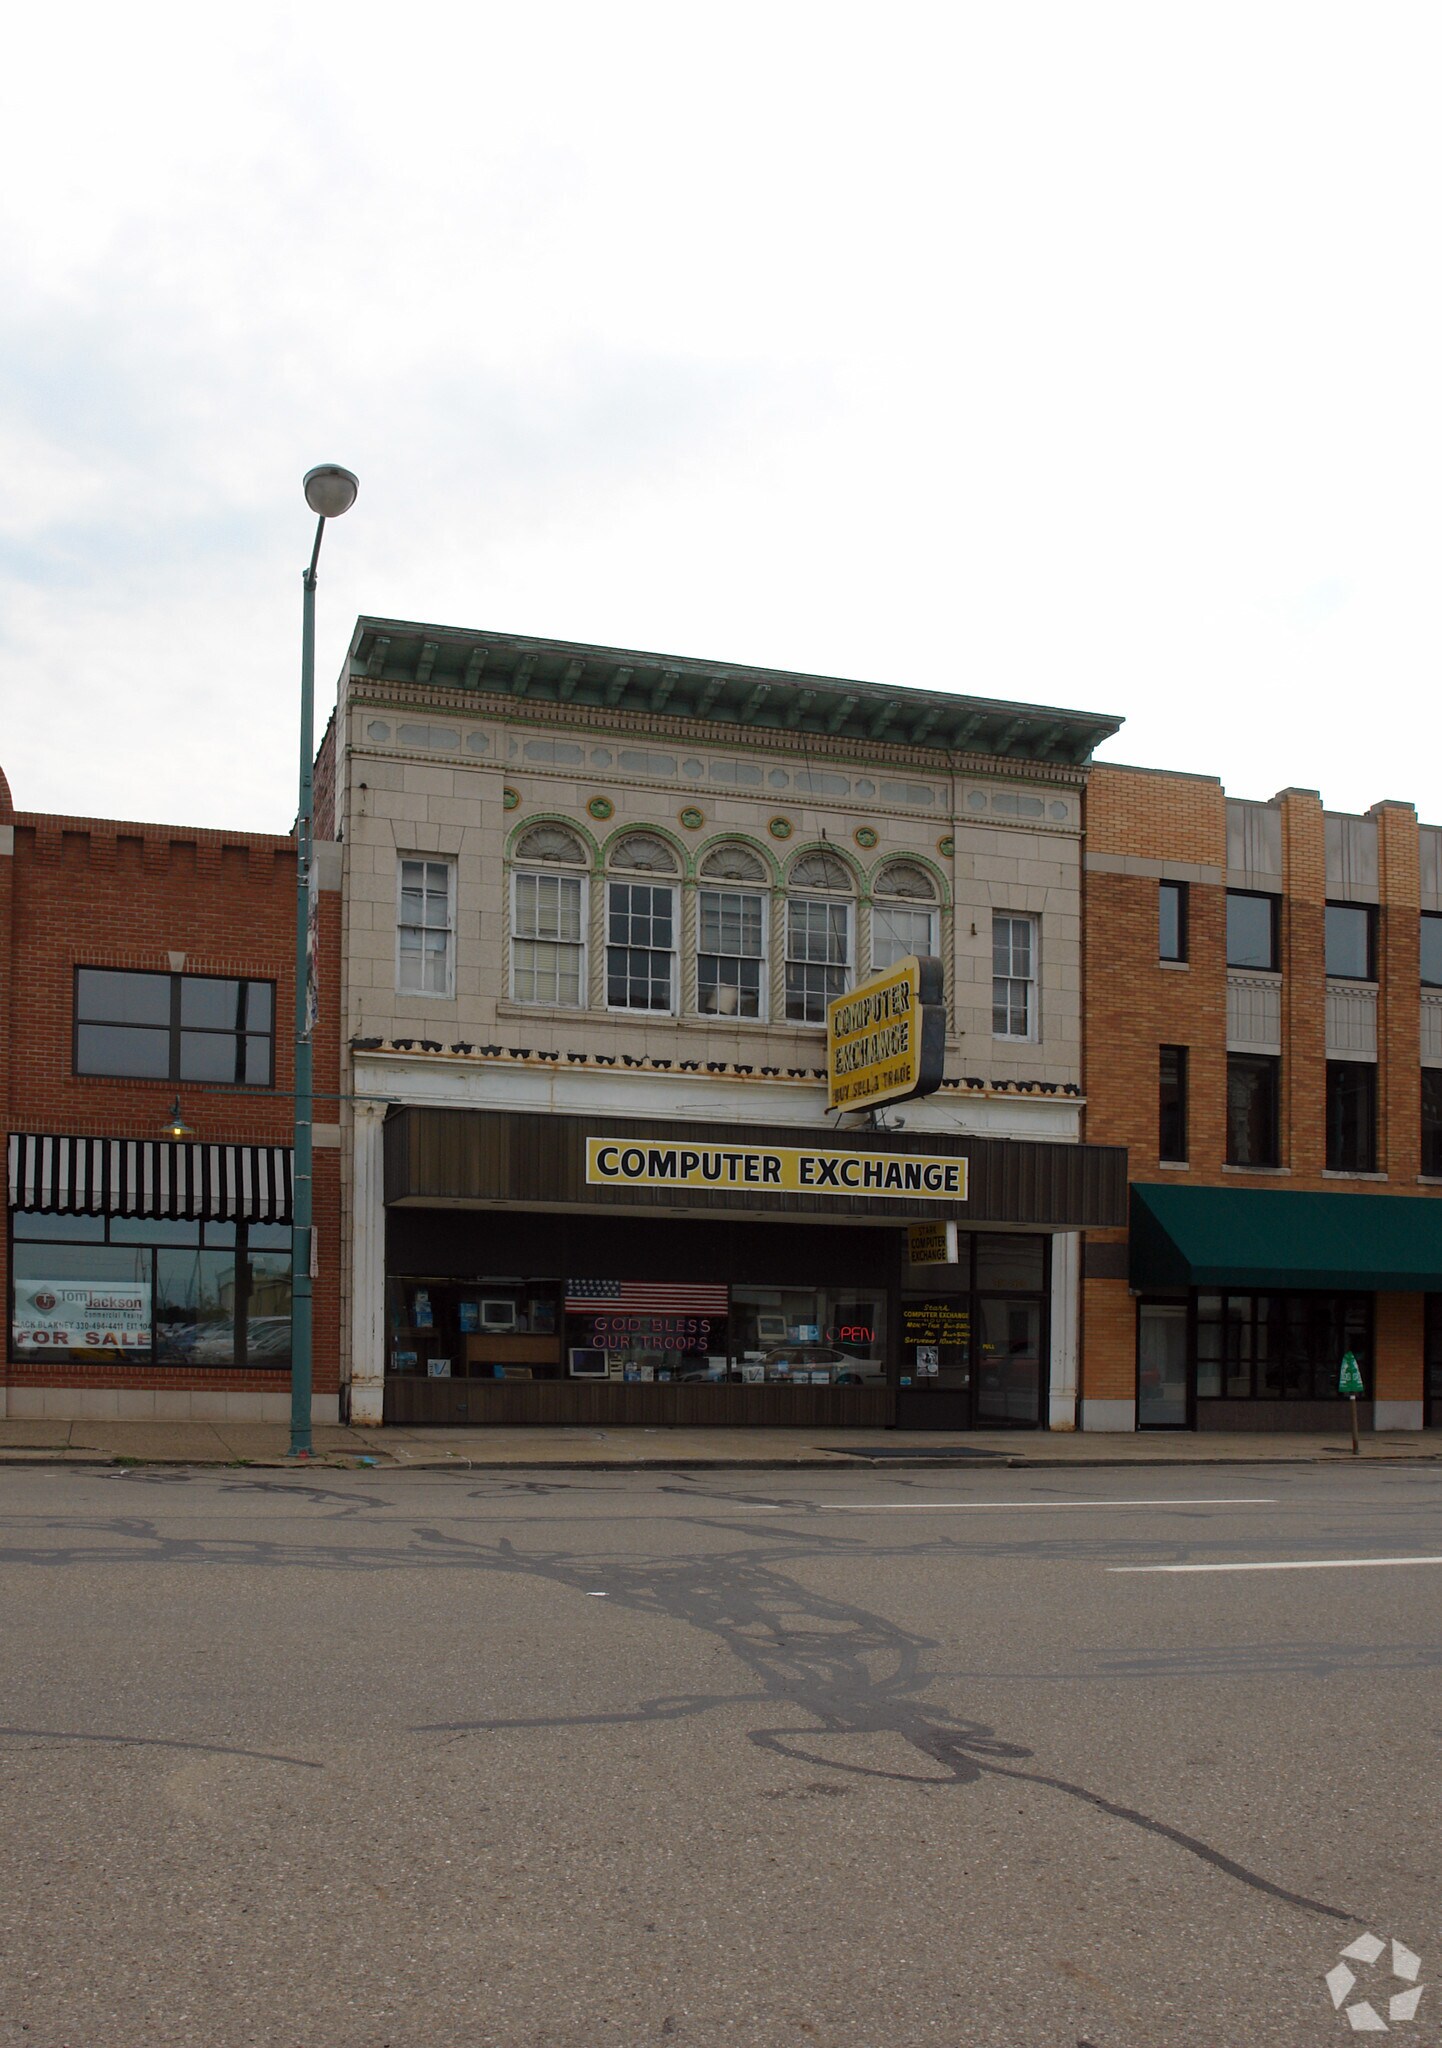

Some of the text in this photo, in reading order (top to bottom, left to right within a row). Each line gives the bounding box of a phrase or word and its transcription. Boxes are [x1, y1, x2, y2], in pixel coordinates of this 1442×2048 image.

[834, 981, 911, 1038] COMPUTER
[835, 1021, 909, 1076] EXCHANGE
[834, 1084, 849, 1102] BUY
[883, 1065, 911, 1088] TRADE
[597, 1147, 960, 1192] COMPUTER EXCHANGE
[911, 1235, 946, 1249] COMPUTER
[911, 1248, 946, 1262] EXCHANGE
[60, 1290, 87, 1302] Tom
[85, 1291, 142, 1308] Jackson
[84, 1311, 121, 1319] Commercial
[939, 1311, 970, 1319] EXCHANGE
[594, 1317, 711, 1333] GOD BLESS
[17, 1331, 151, 1346] FOR SALE
[826, 1326, 875, 1342] OPEN
[592, 1334, 709, 1351] OUR TROOPS
